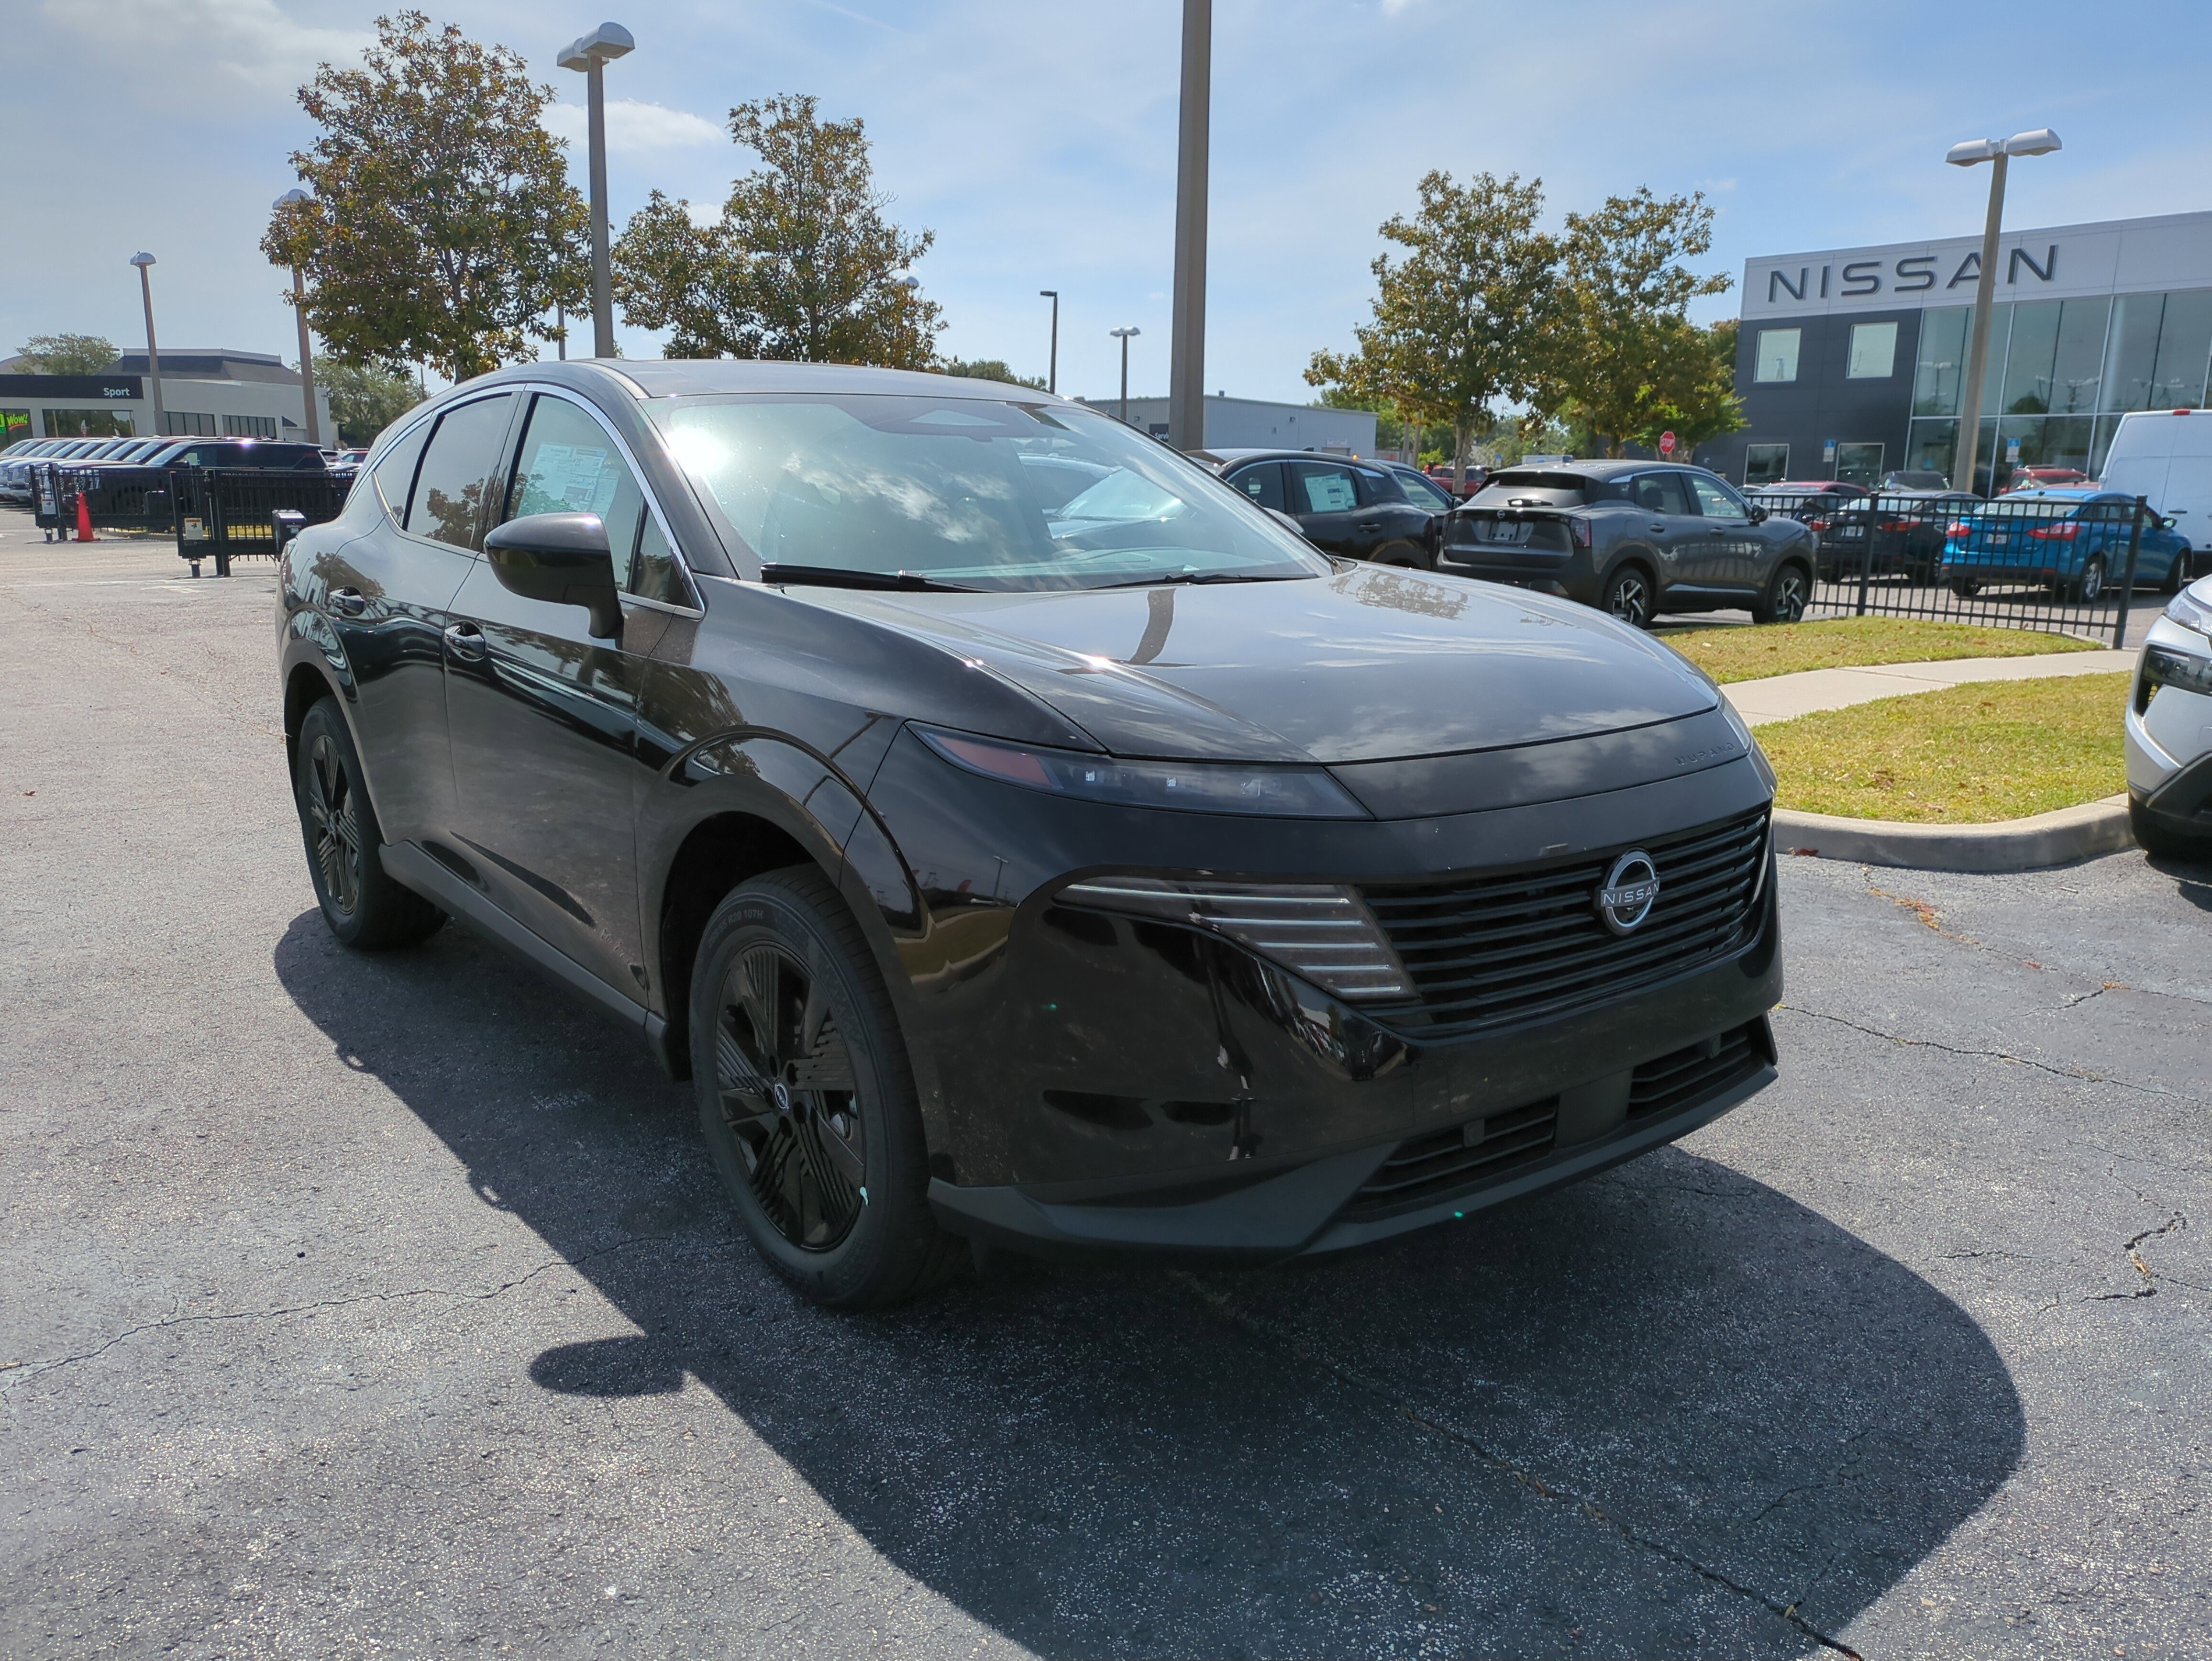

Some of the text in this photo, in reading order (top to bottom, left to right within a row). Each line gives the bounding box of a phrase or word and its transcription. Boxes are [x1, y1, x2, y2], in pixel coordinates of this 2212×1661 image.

[1767, 244, 2058, 303] NISSAN
[103, 388, 130, 398] Sport
[1674, 742, 1735, 766] MURANO
[1603, 880, 1660, 905] NISSAN
[728, 910, 741, 926] R20
[743, 909, 763, 919] 107H
